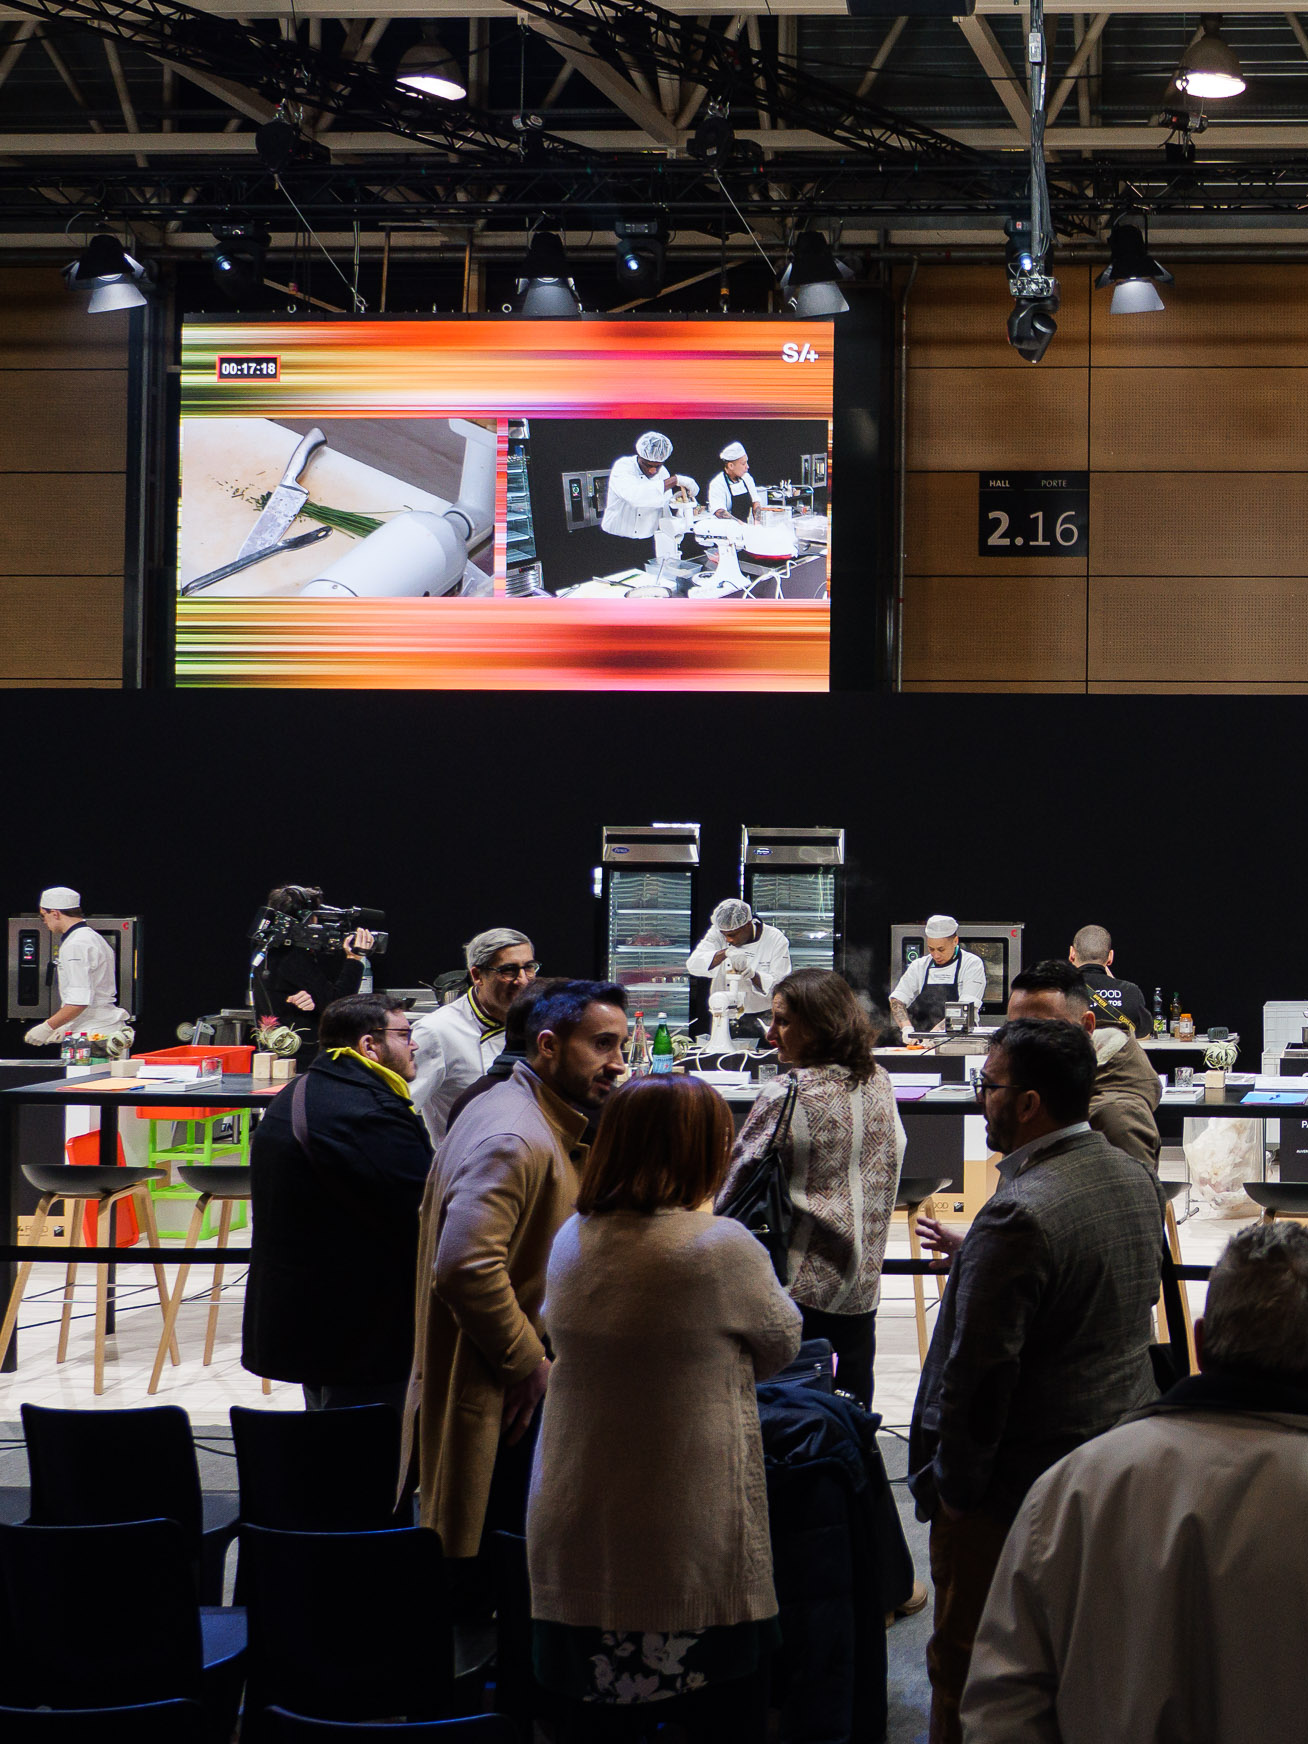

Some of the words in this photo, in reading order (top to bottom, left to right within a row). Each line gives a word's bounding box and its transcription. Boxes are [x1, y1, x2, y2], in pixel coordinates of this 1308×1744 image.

[221, 362, 276, 375] 00:17:18
[989, 479, 1011, 488] HALL
[1041, 479, 1068, 488] PORTE
